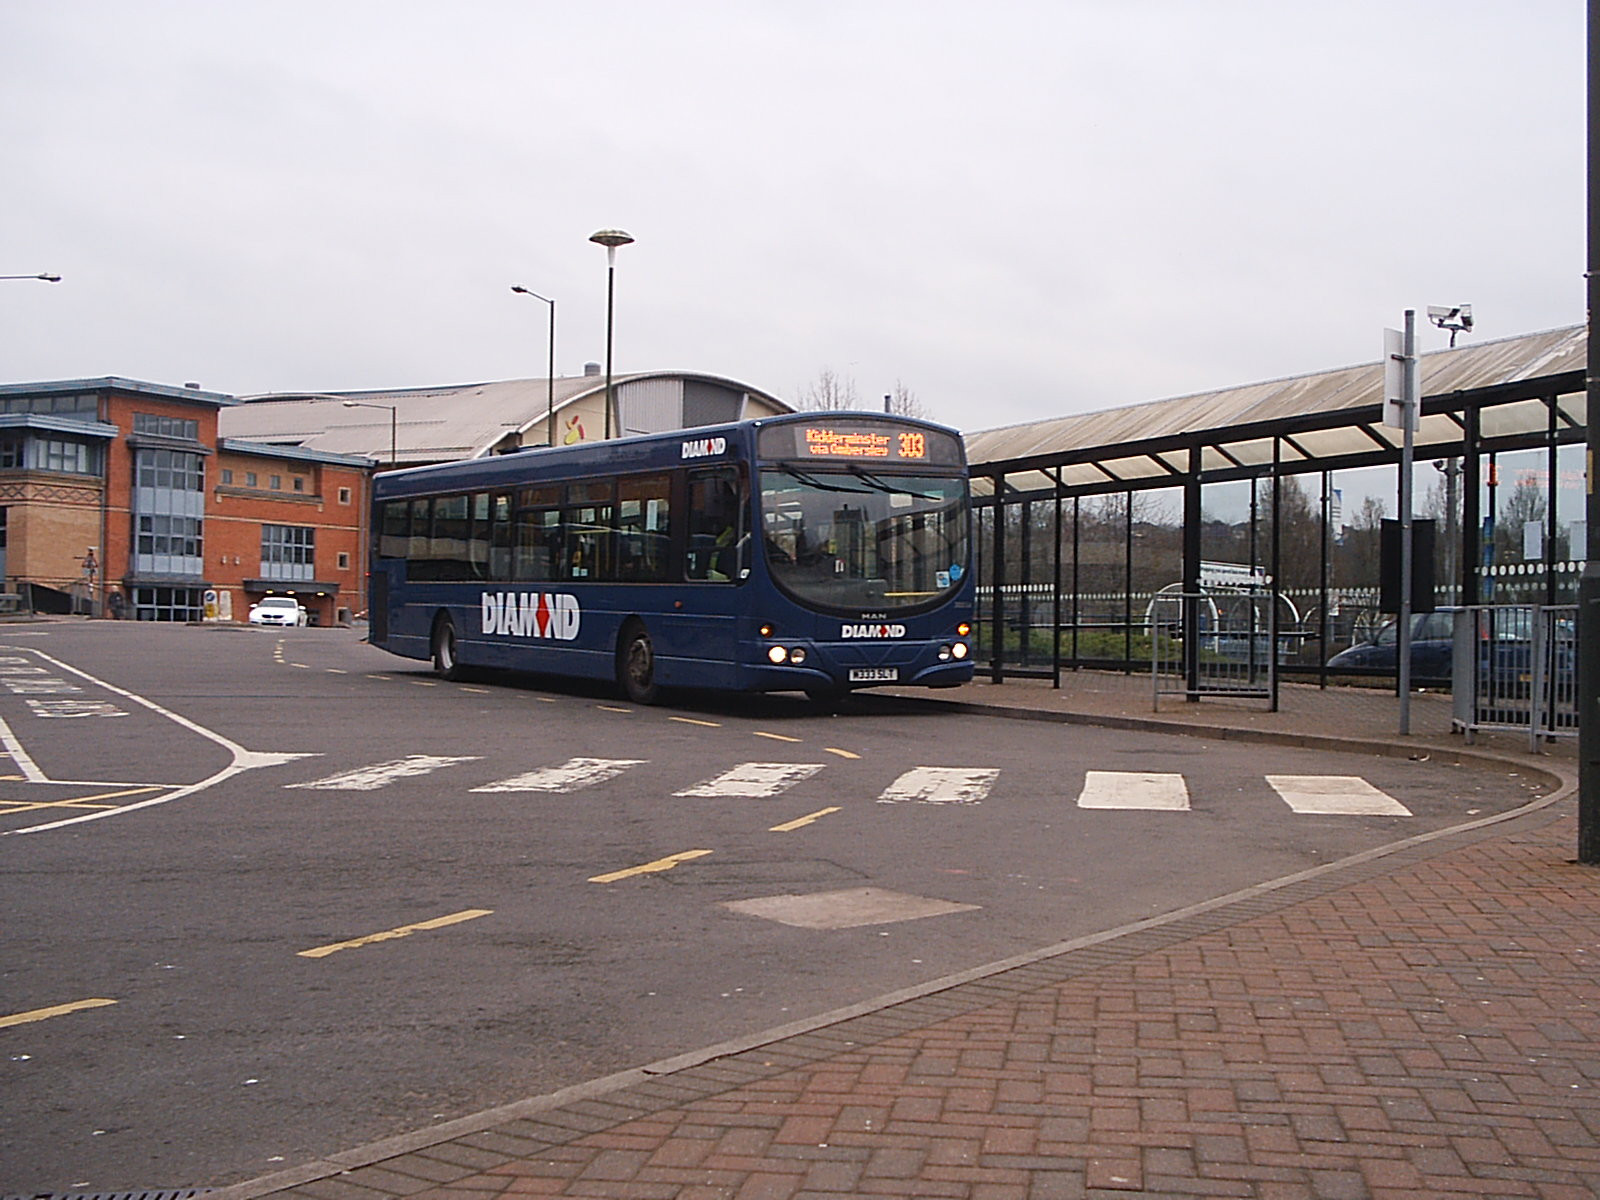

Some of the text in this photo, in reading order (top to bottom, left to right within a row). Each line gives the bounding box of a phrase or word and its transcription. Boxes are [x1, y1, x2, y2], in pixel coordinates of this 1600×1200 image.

[806, 429, 891, 445] Kidderminster
[898, 433, 924, 458] 303
[681, 438, 726, 459] DIAMOND
[809, 443, 829, 454] via
[482, 592, 581, 641] DIAMOND
[841, 624, 906, 638] DIAMOND
